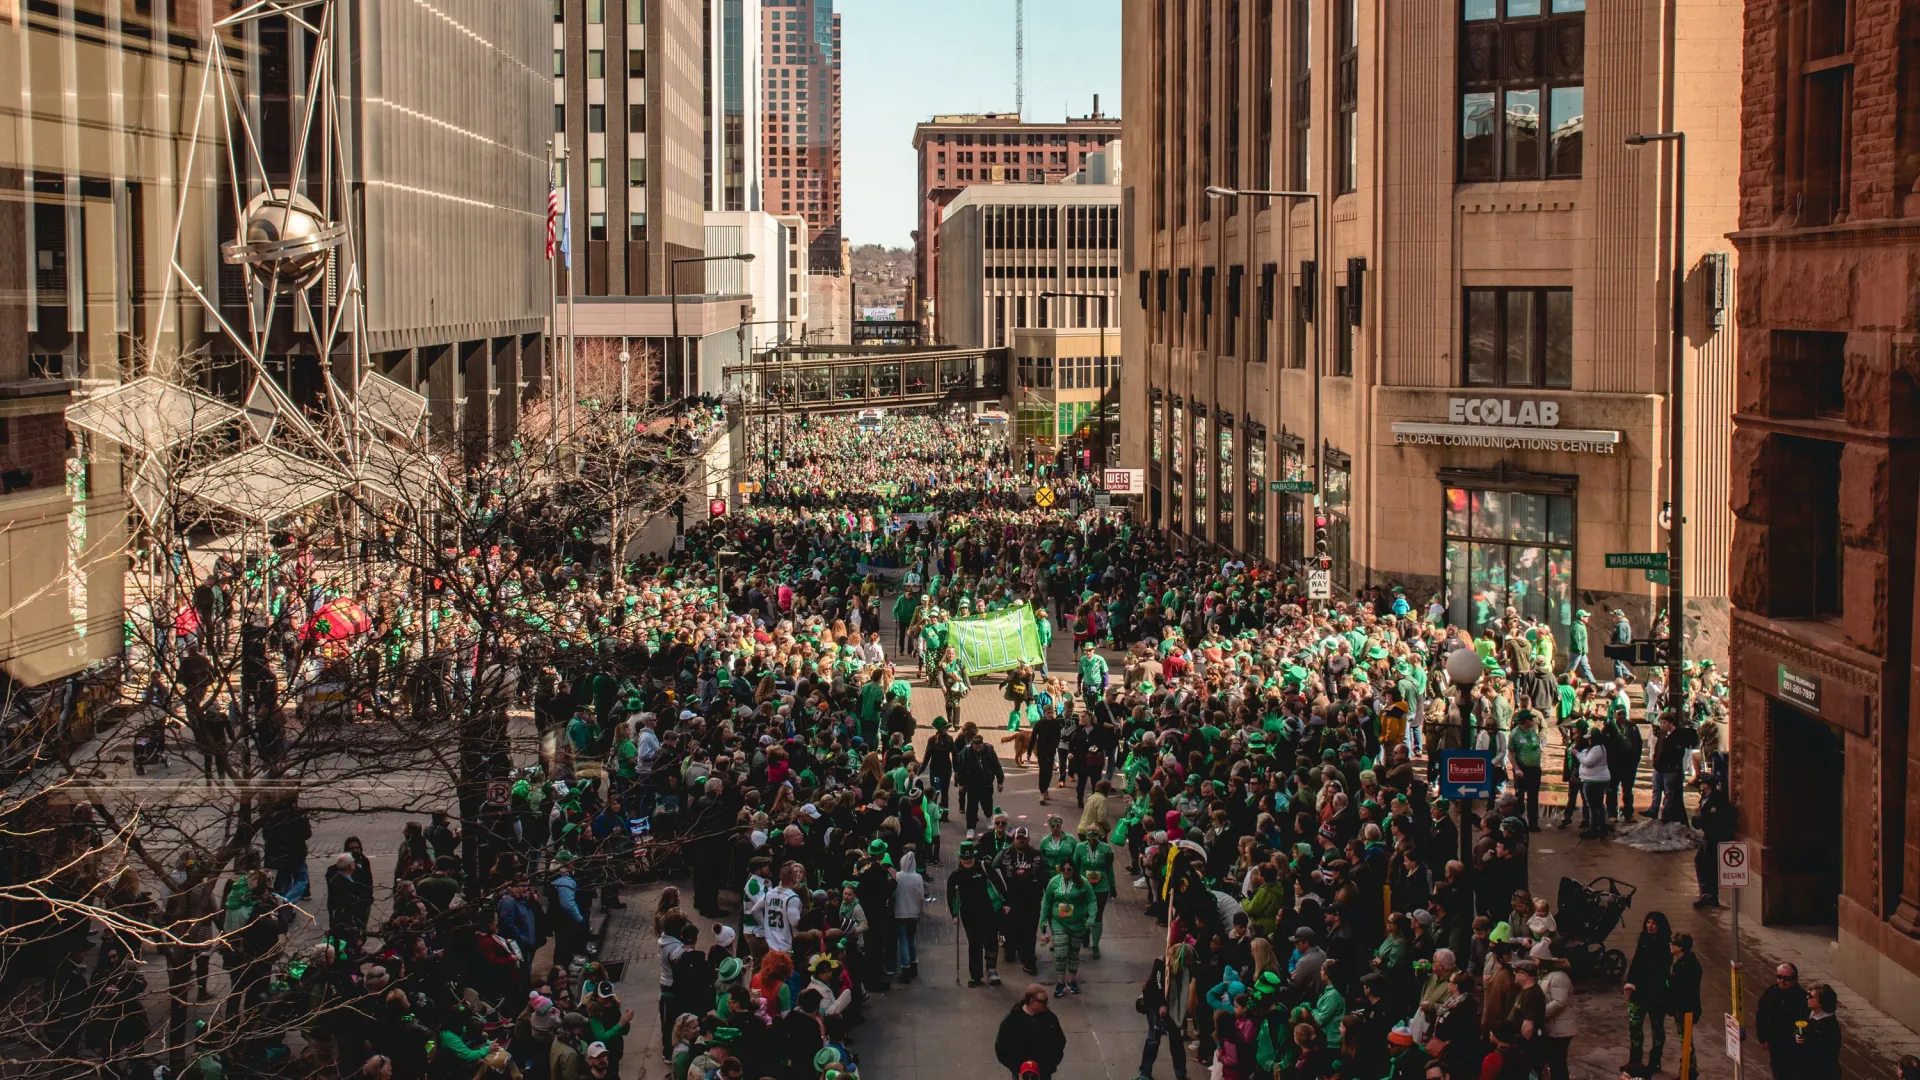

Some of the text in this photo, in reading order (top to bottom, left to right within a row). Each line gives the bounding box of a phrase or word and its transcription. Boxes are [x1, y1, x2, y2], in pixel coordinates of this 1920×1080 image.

[1449, 398, 1560, 426] ECOLAB
[1394, 432, 1614, 454] GLOBAL COMMUNICATIONS CENTER
[1106, 473, 1129, 483] WEIS
[1609, 556, 1652, 565] WABASHA
[954, 609, 1025, 673] KELLY
[1450, 764, 1484, 774] Fitzgerald
[1723, 872, 1746, 880] BEGINS
[768, 909, 784, 929] 23
